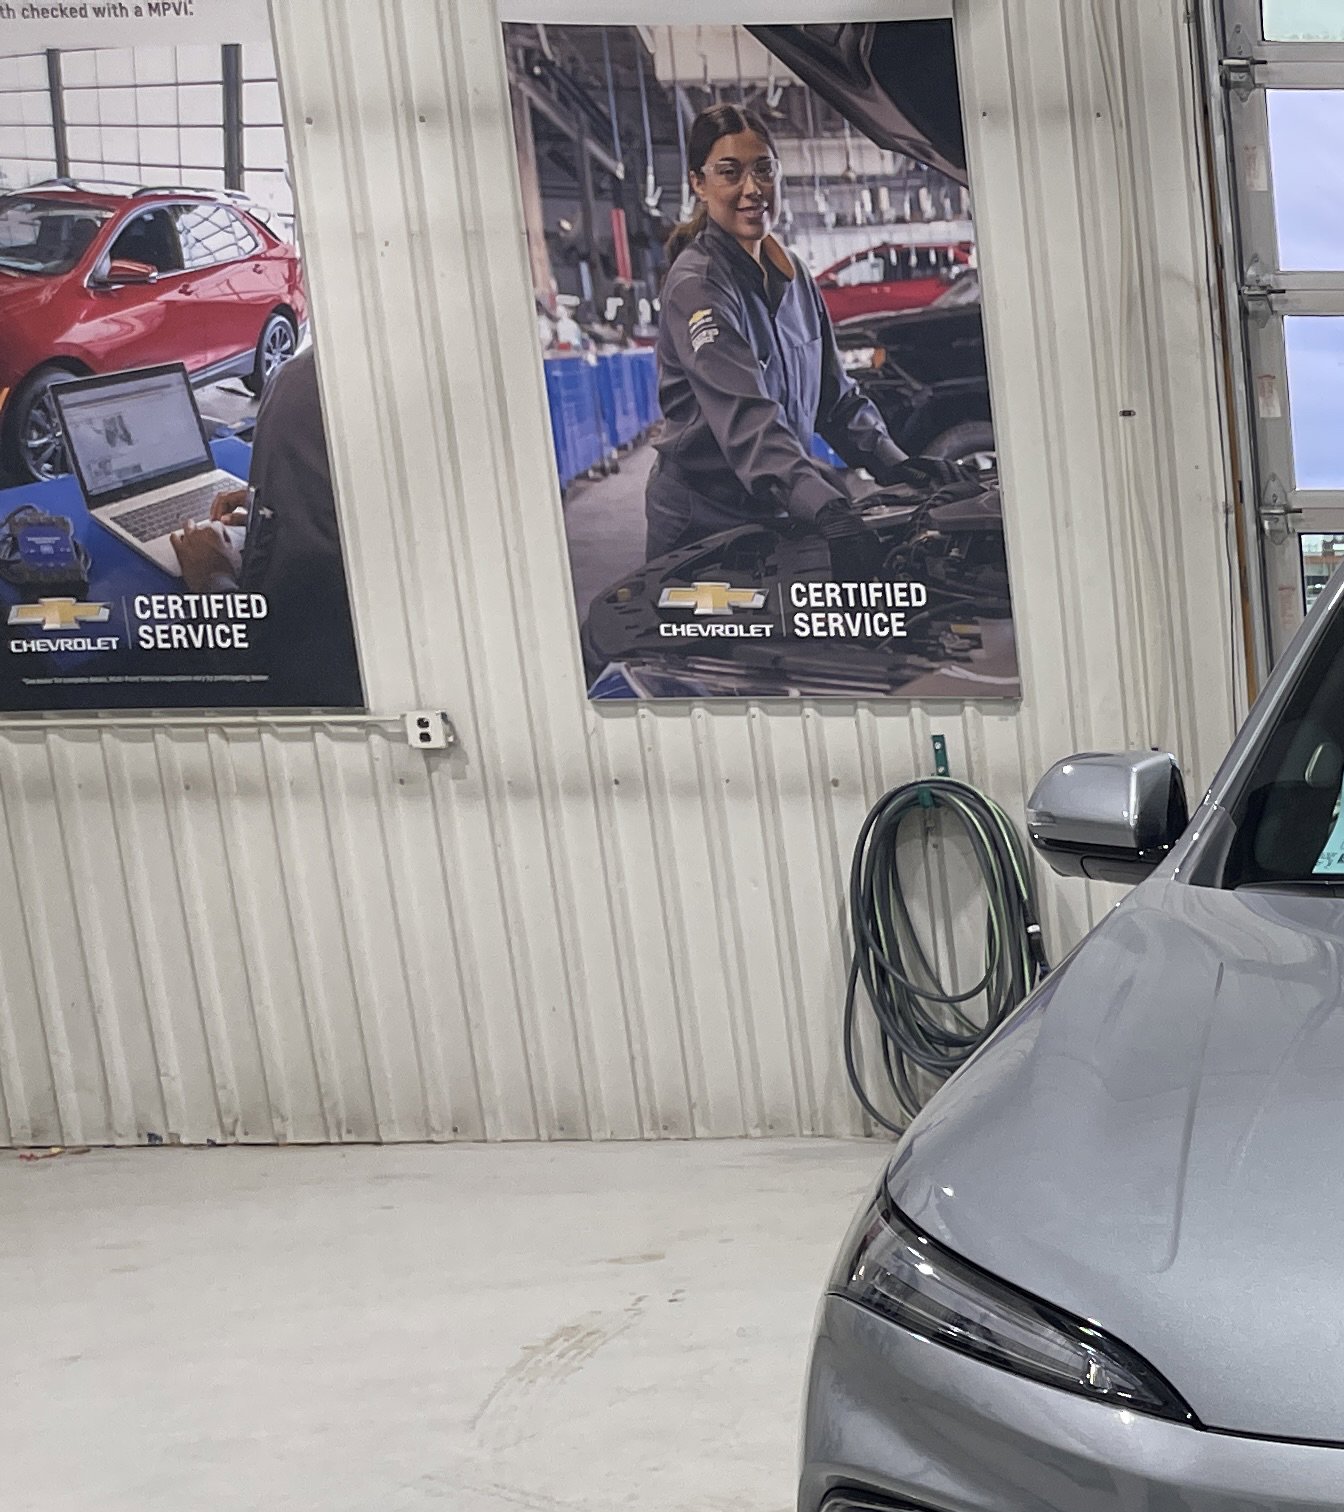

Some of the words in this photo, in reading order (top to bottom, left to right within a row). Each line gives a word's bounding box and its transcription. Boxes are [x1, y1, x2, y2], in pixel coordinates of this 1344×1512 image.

[21, 3, 88, 19] checked
[93, 3, 129, 18] with
[134, 6, 144, 17] a
[134, 593, 269, 620] CERTIFIED
[790, 582, 928, 608] CERTIFIED
[138, 623, 250, 649] SERVICE
[659, 623, 774, 637] CHEVROLET
[793, 612, 908, 638] SERVICE
[10, 637, 120, 653] CHEVROLET
